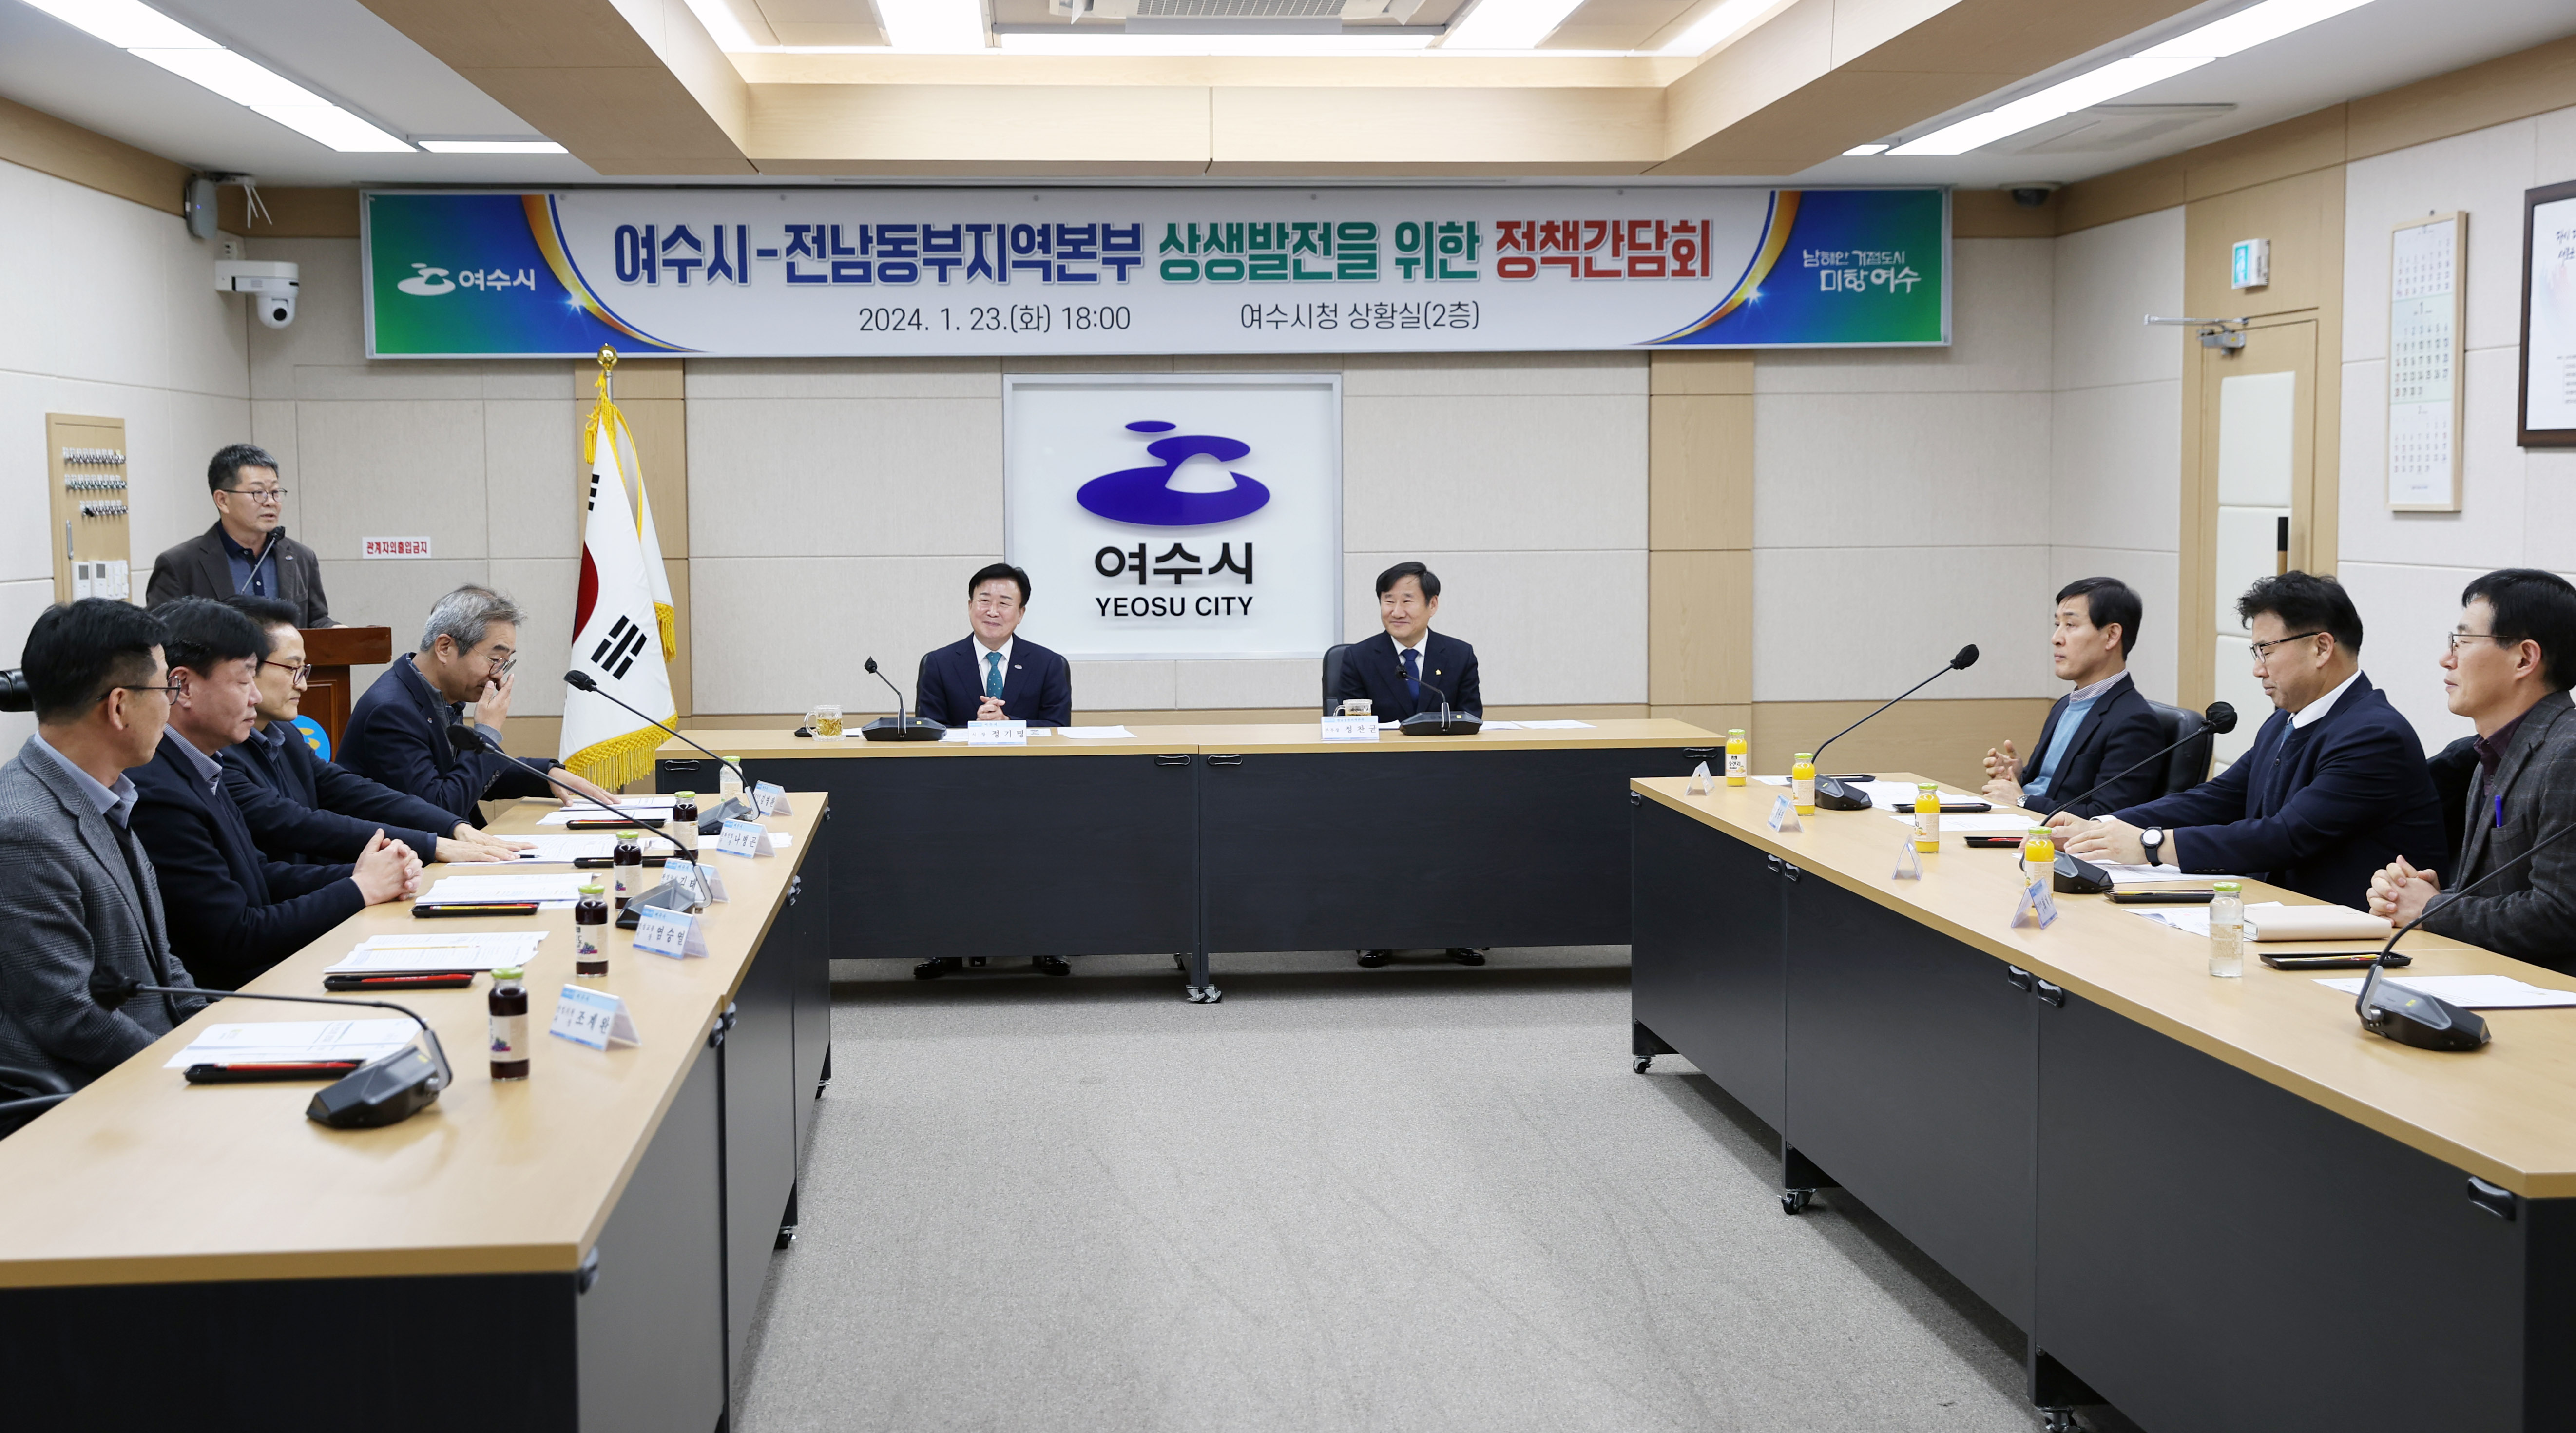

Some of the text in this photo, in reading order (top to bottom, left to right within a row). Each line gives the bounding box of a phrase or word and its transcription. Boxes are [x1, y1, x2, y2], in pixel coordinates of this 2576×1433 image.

[614, 219, 1711, 285] 여수시-전남동부지역본부 상생발전을 위한 정책간담회
[458, 268, 536, 291] 여수시
[1820, 267, 1922, 294] 미항 여수
[859, 304, 1131, 334] 2024. 1. 23.(화) 18:00
[1240, 300, 1479, 330] 여수시청 상황실(2층)
[1095, 542, 1253, 585] 여수시
[1095, 596, 1253, 617] YEOSU CITY
[991, 729, 1024, 738] 정기명
